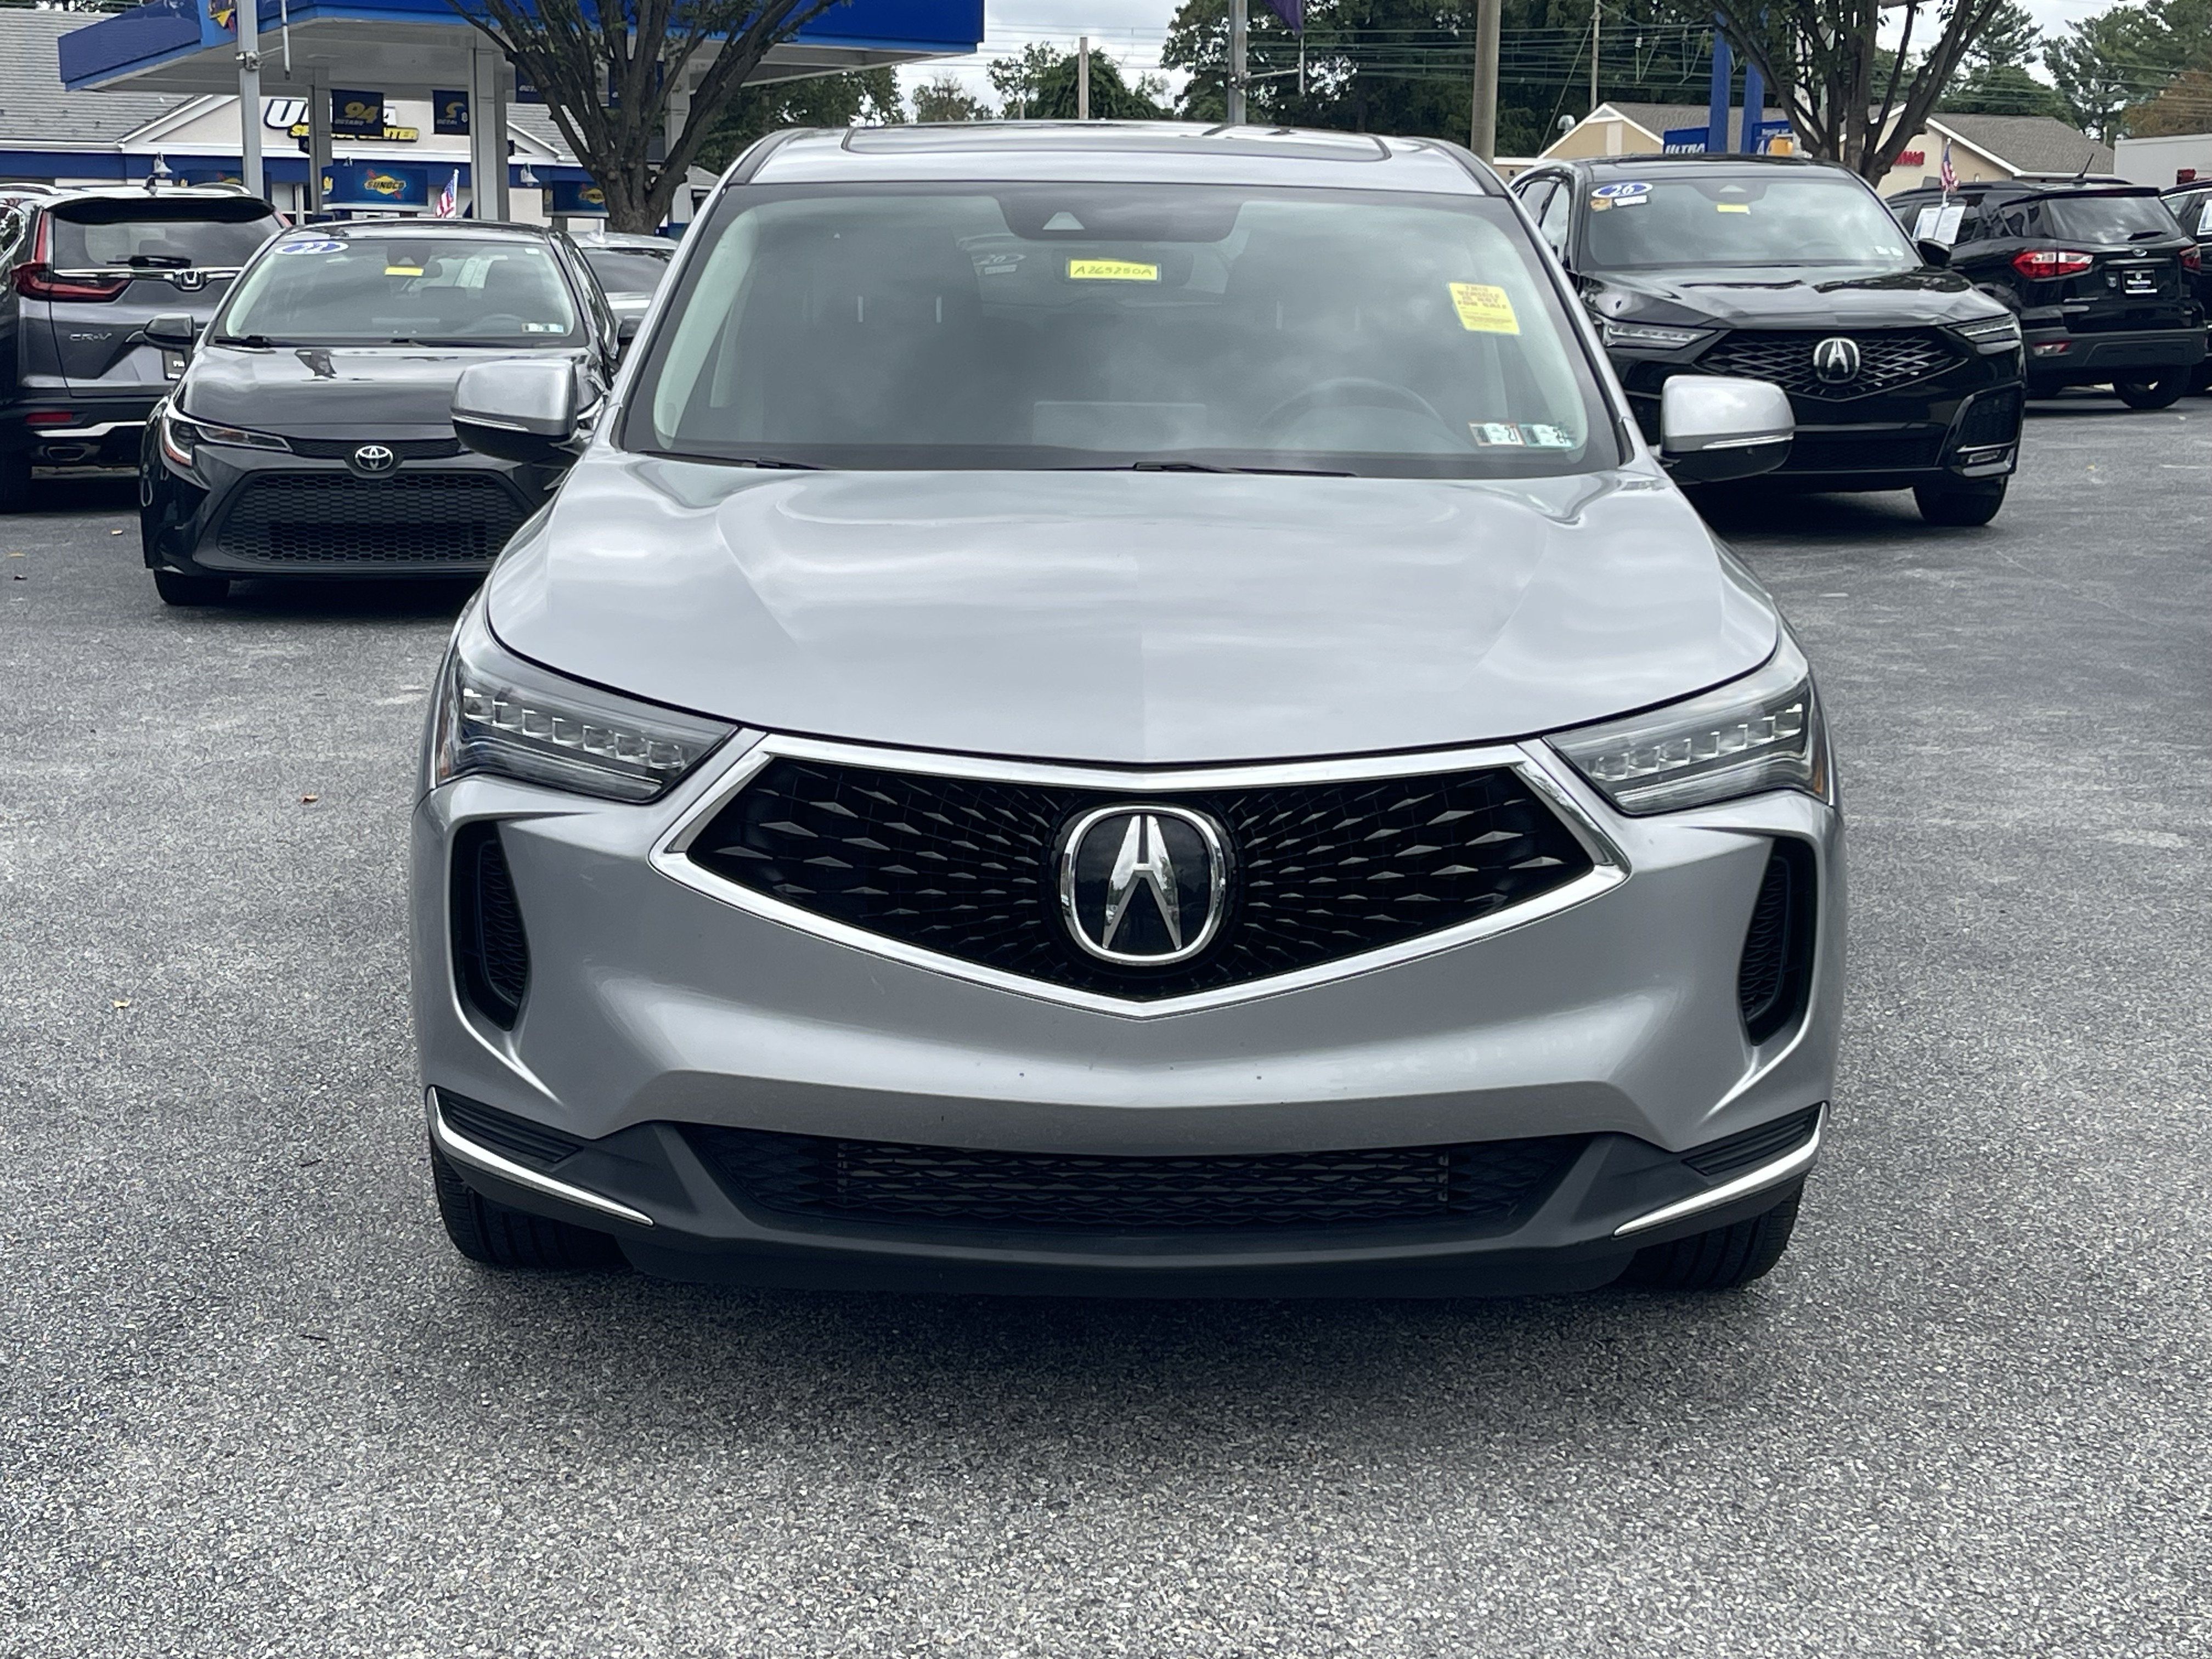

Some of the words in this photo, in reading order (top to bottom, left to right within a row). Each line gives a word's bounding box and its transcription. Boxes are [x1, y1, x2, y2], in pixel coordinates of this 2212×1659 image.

[343, 101, 379, 123] 94
[366, 181, 404, 189] SUNOCO
[1610, 184, 1635, 196] 26
